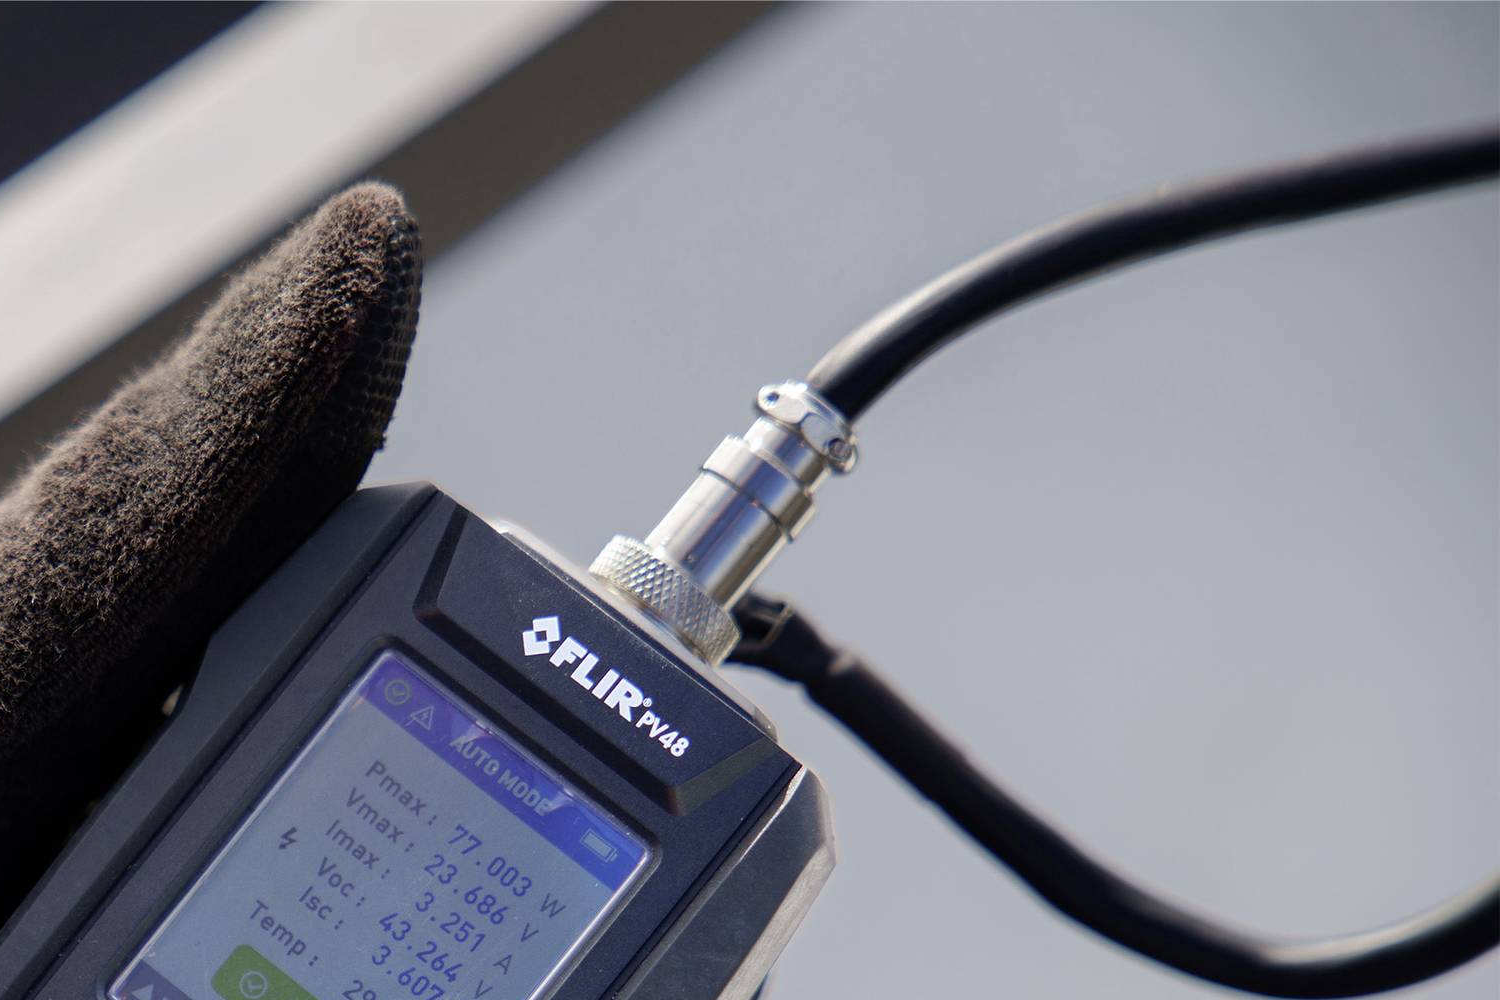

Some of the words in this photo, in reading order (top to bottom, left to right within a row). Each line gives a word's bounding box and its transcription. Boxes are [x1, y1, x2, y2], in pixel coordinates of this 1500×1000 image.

[449, 736, 499, 776] AUTO
[497, 769, 555, 816] MODE
[635, 711, 690, 758] PV48
[424, 854, 508, 925] 23.686
[521, 922, 539, 942] V
[448, 824, 532, 897] 77.003
[540, 893, 567, 918] W
[379, 912, 463, 983] 43.264
[474, 979, 493, 999] V
[415, 892, 486, 952] 3.251
[493, 954, 512, 975] A
